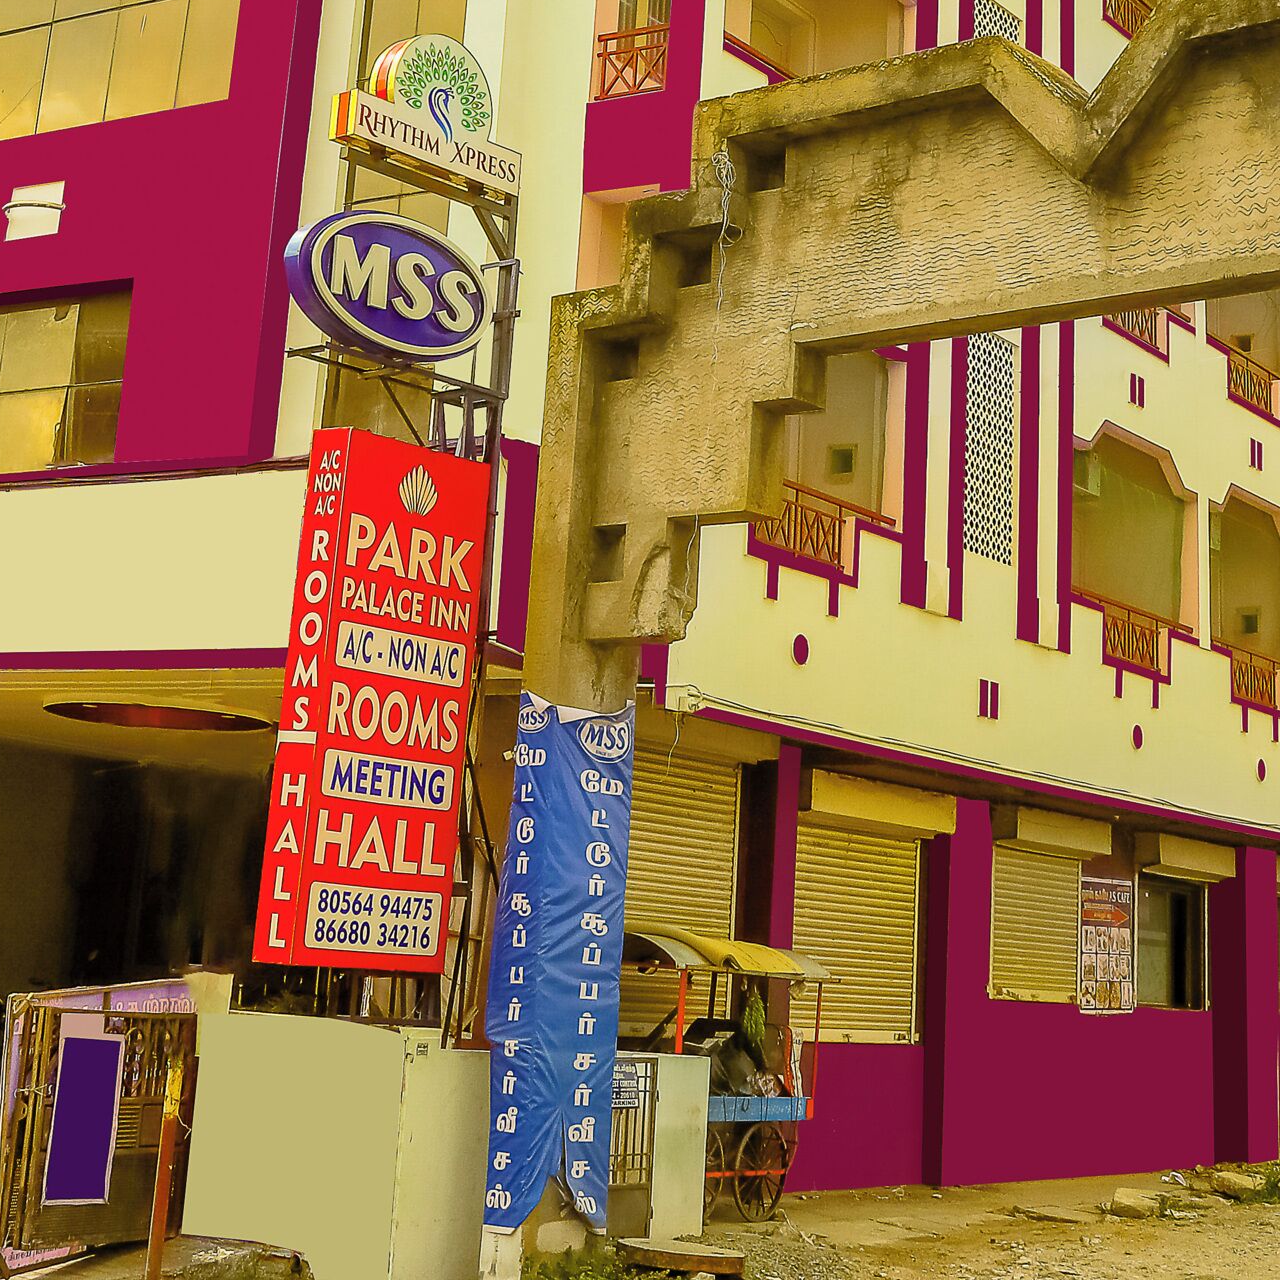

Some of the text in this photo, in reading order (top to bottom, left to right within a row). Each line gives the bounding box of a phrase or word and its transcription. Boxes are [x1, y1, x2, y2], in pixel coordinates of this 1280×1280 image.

[358, 103, 516, 184] RHYTHM XPRESS
[330, 234, 477, 333] MSS
[314, 472, 341, 493] NON
[320, 449, 341, 471] A/C
[314, 495, 335, 517] A/C
[345, 512, 474, 593] PARK
[341, 576, 471, 634] PALACE INN
[343, 628, 374, 665] A/C
[389, 636, 426, 674] NON
[430, 642, 460, 680] A/C
[327, 681, 459, 753] ROOMS
[520, 710, 546, 726] MSS
[585, 723, 627, 751] MSS
[330, 755, 445, 805] MEETING
[313, 809, 446, 877] HALL
[318, 889, 433, 921] 80564 94475
[314, 918, 431, 949] 86680 34216
